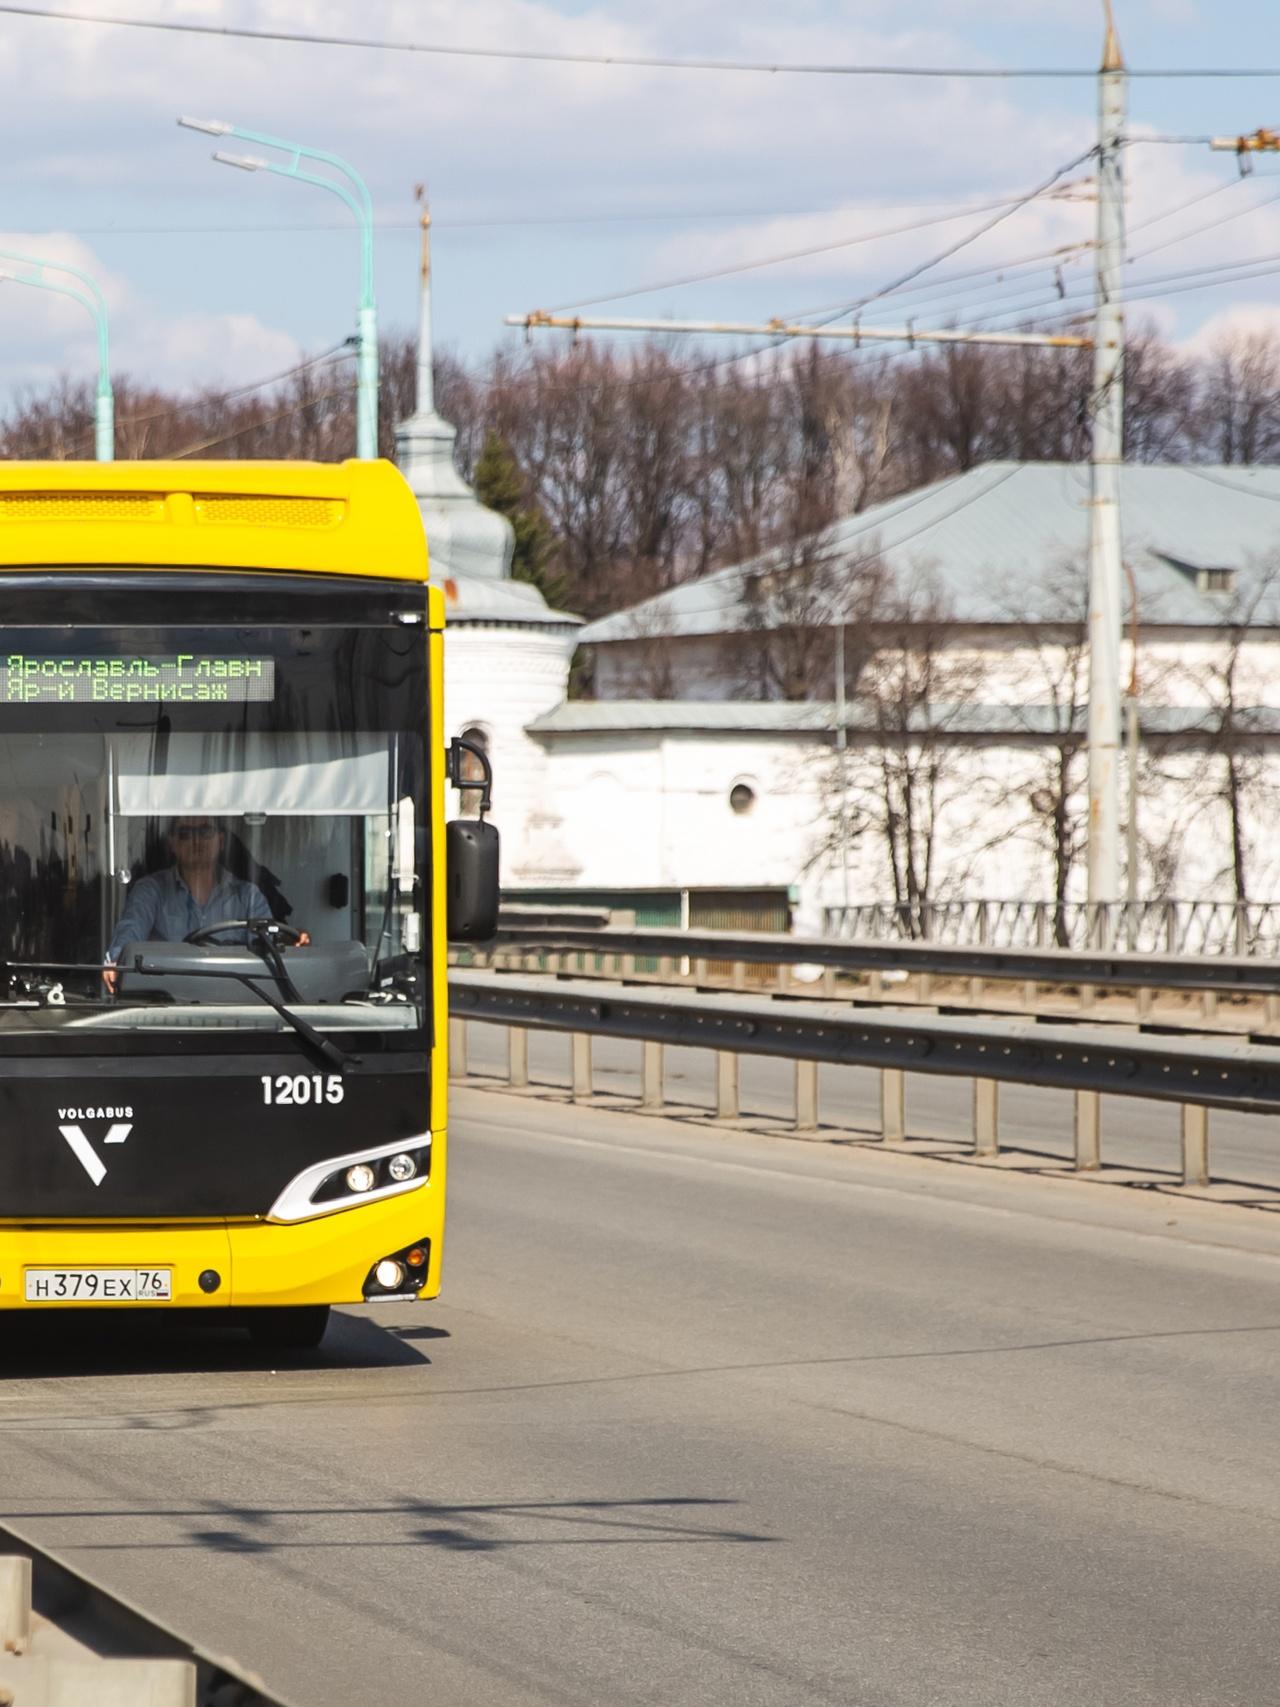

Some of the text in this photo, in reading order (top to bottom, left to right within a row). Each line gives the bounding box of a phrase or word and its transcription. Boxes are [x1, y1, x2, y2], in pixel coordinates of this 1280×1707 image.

[6, 655, 262, 678] Ярославль-Главн
[93, 679, 227, 702] Вернисаж
[261, 1075, 344, 1104] 12015
[58, 1106, 133, 1119] VOLGABUS
[140, 1272, 162, 1290] 76
